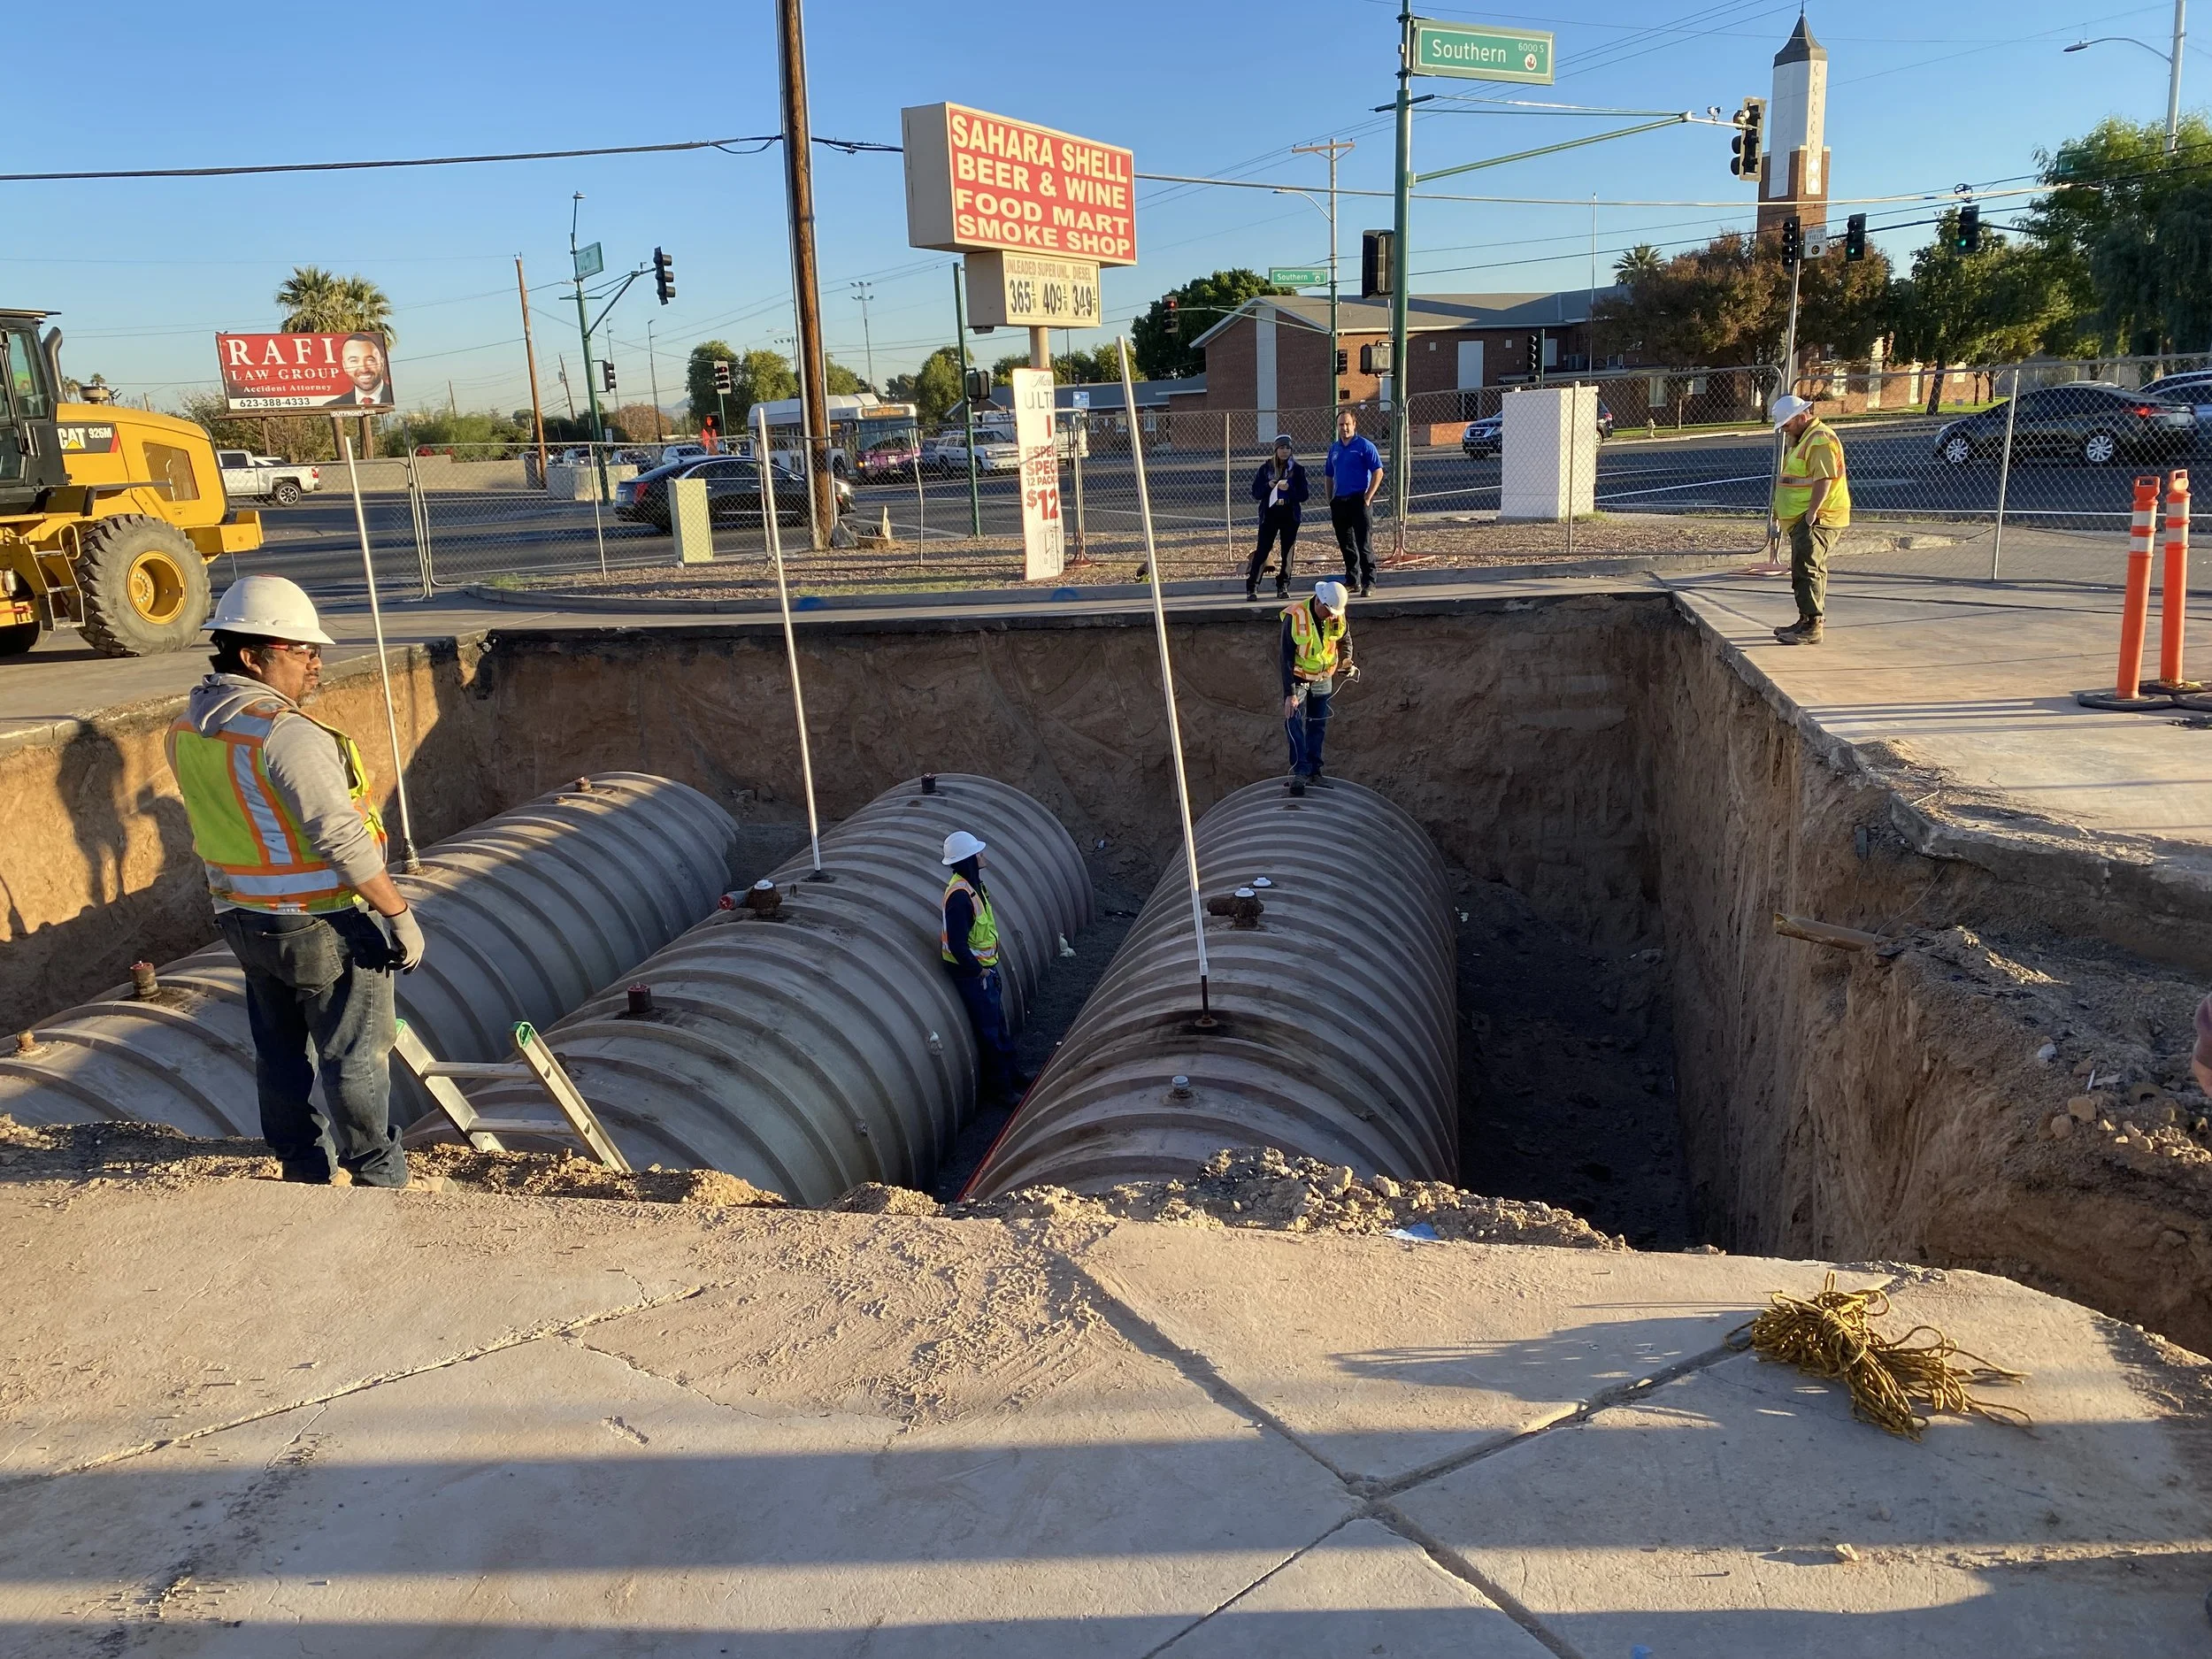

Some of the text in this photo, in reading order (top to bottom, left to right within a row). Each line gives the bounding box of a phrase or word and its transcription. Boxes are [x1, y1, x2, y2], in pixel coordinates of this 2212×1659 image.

[1432, 39, 1507, 63] Southern
[1517, 42, 1545, 53] 6000 S
[951, 114, 1128, 184] SAHARA SHELL
[956, 152, 1126, 210] BEER & WINE
[956, 188, 1129, 235] FOOD MART
[958, 215, 1131, 256] SMOKE SHOP
[1005, 258, 1037, 275] UNLEADED
[1037, 262, 1056, 278] SUPER
[1072, 266, 1092, 280] DIESEL
[1010, 279, 1032, 313] 365
[1043, 282, 1063, 315] 409
[1072, 284, 1093, 317] 349
[226, 337, 337, 366] RAFI
[231, 367, 339, 381] LAW GROUP
[239, 397, 311, 408] 623-388-4333
[58, 426, 112, 449] CAT 926M
[1026, 477, 1035, 487] 12
[1026, 488, 1059, 520] $12
